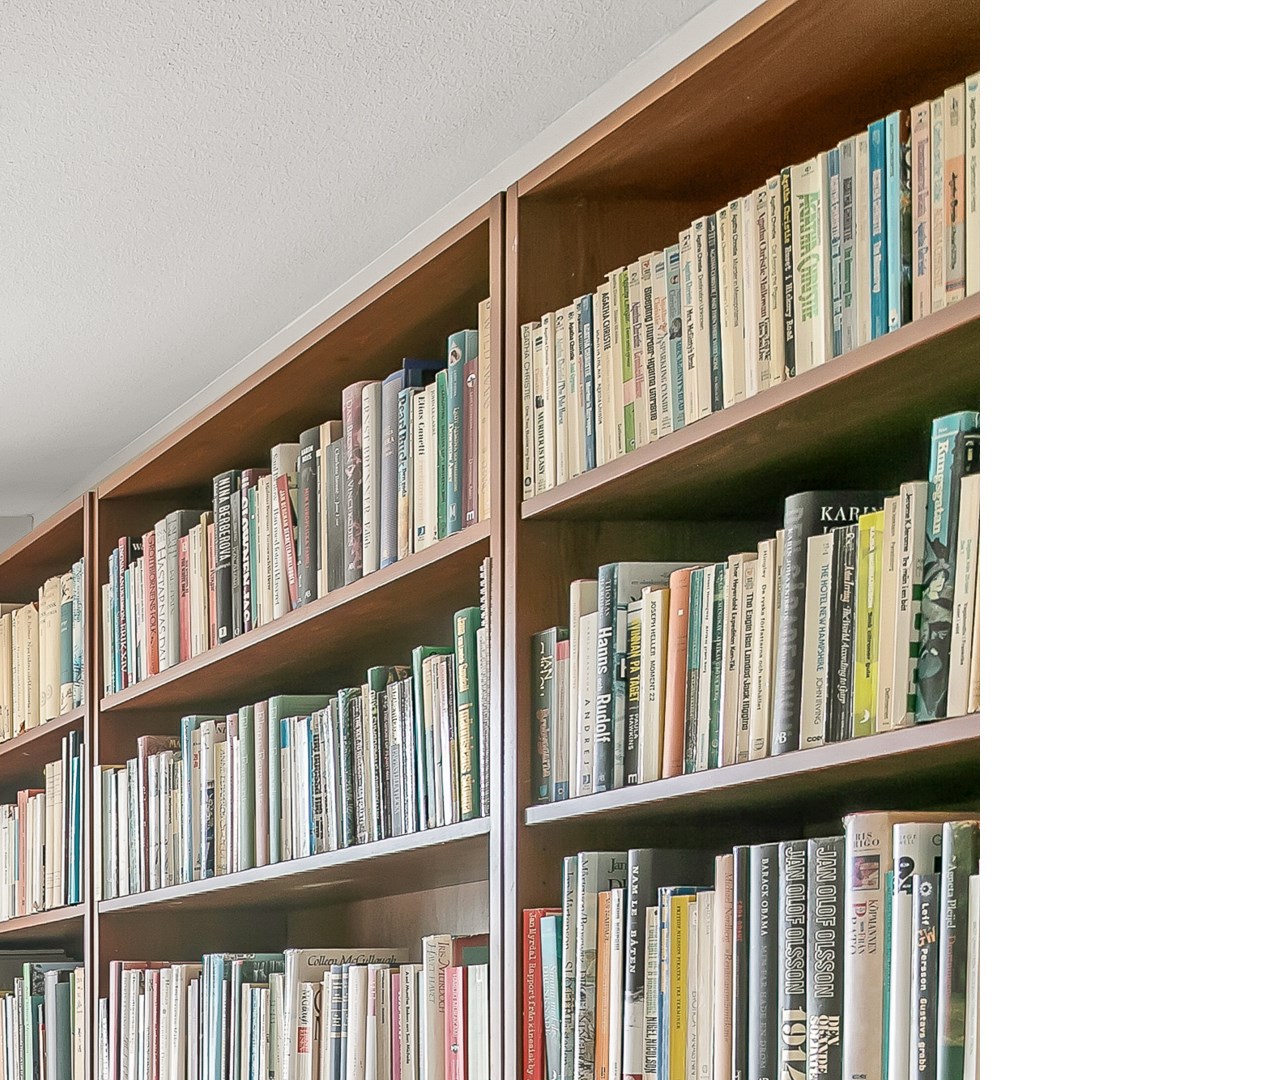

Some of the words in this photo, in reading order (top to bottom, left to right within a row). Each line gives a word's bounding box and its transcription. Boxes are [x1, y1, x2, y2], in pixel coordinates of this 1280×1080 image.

[781, 173, 791, 204] Agatha
[783, 206, 792, 244] Christie
[758, 241, 770, 276] Christie
[784, 247, 793, 272] Huset
[602, 291, 610, 320] AGATHA
[523, 326, 532, 359] AGATHA
[603, 320, 612, 351] CHRISTIE
[786, 320, 795, 342] Road
[523, 361, 532, 401] CHRISTIE
[417, 396, 427, 420] Elias
[417, 421, 427, 456] Canetti
[218, 476, 231, 502] NINA
[931, 440, 949, 537] Kungsgatan
[219, 504, 231, 562] BERBEROVA
[821, 564, 830, 578] THE
[746, 592, 754, 608] The
[819, 579, 829, 605] HOTEL
[818, 606, 828, 626] NEW
[596, 626, 613, 675] Hanns
[742, 649, 752, 680] Landed
[816, 626, 827, 672] HAMPSHIRE
[648, 660, 656, 691] MOMENT
[814, 677, 824, 698] JOHN
[648, 692, 656, 702] 22
[813, 698, 823, 725] IRVING
[595, 692, 612, 744] Rudolf
[627, 713, 635, 751] HAWKINS
[630, 865, 640, 895] NAM
[760, 858, 769, 898] BARACK
[784, 846, 806, 881] JAN
[813, 846, 836, 881] JAN
[630, 900, 640, 918] LE
[760, 900, 769, 937] OBAMA
[785, 883, 805, 925] OLOF
[814, 883, 836, 926] OLOF
[920, 901, 931, 926] Leif
[437, 941, 450, 958] IRIS
[628, 929, 640, 975] BÅTEN
[784, 929, 805, 995] OLSSON
[813, 929, 835, 998] OLSSON
[526, 963, 537, 1000] Rapport
[919, 948, 930, 992] Persson
[827, 1015, 840, 1047] DEN
[918, 997, 928, 1039] Gustavs
[916, 1042, 927, 1072] grabb
